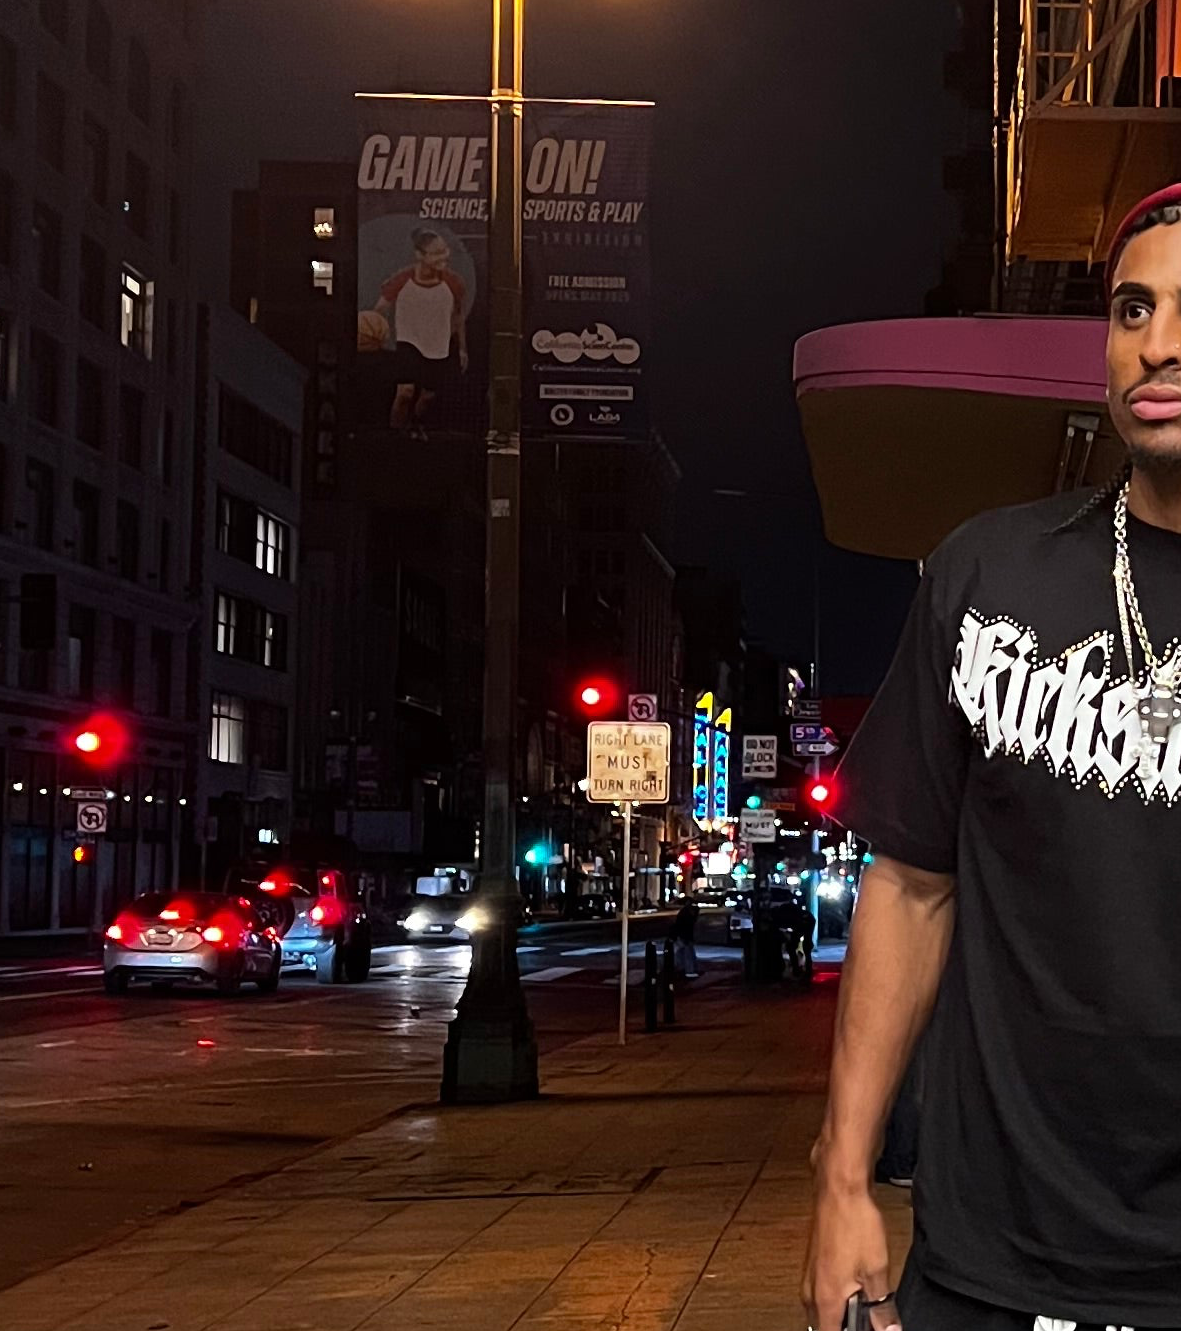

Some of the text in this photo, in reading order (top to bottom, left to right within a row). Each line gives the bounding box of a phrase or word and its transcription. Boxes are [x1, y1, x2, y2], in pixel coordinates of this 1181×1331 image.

[357, 134, 606, 195] GAME ON!
[419, 198, 643, 223] SCIENCE, SPORTS & PLAY
[595, 733, 663, 746] RIGHT LANE
[760, 740, 775, 749] NOT
[608, 755, 649, 770] MUST
[594, 779, 663, 792] TURN RIGHT
